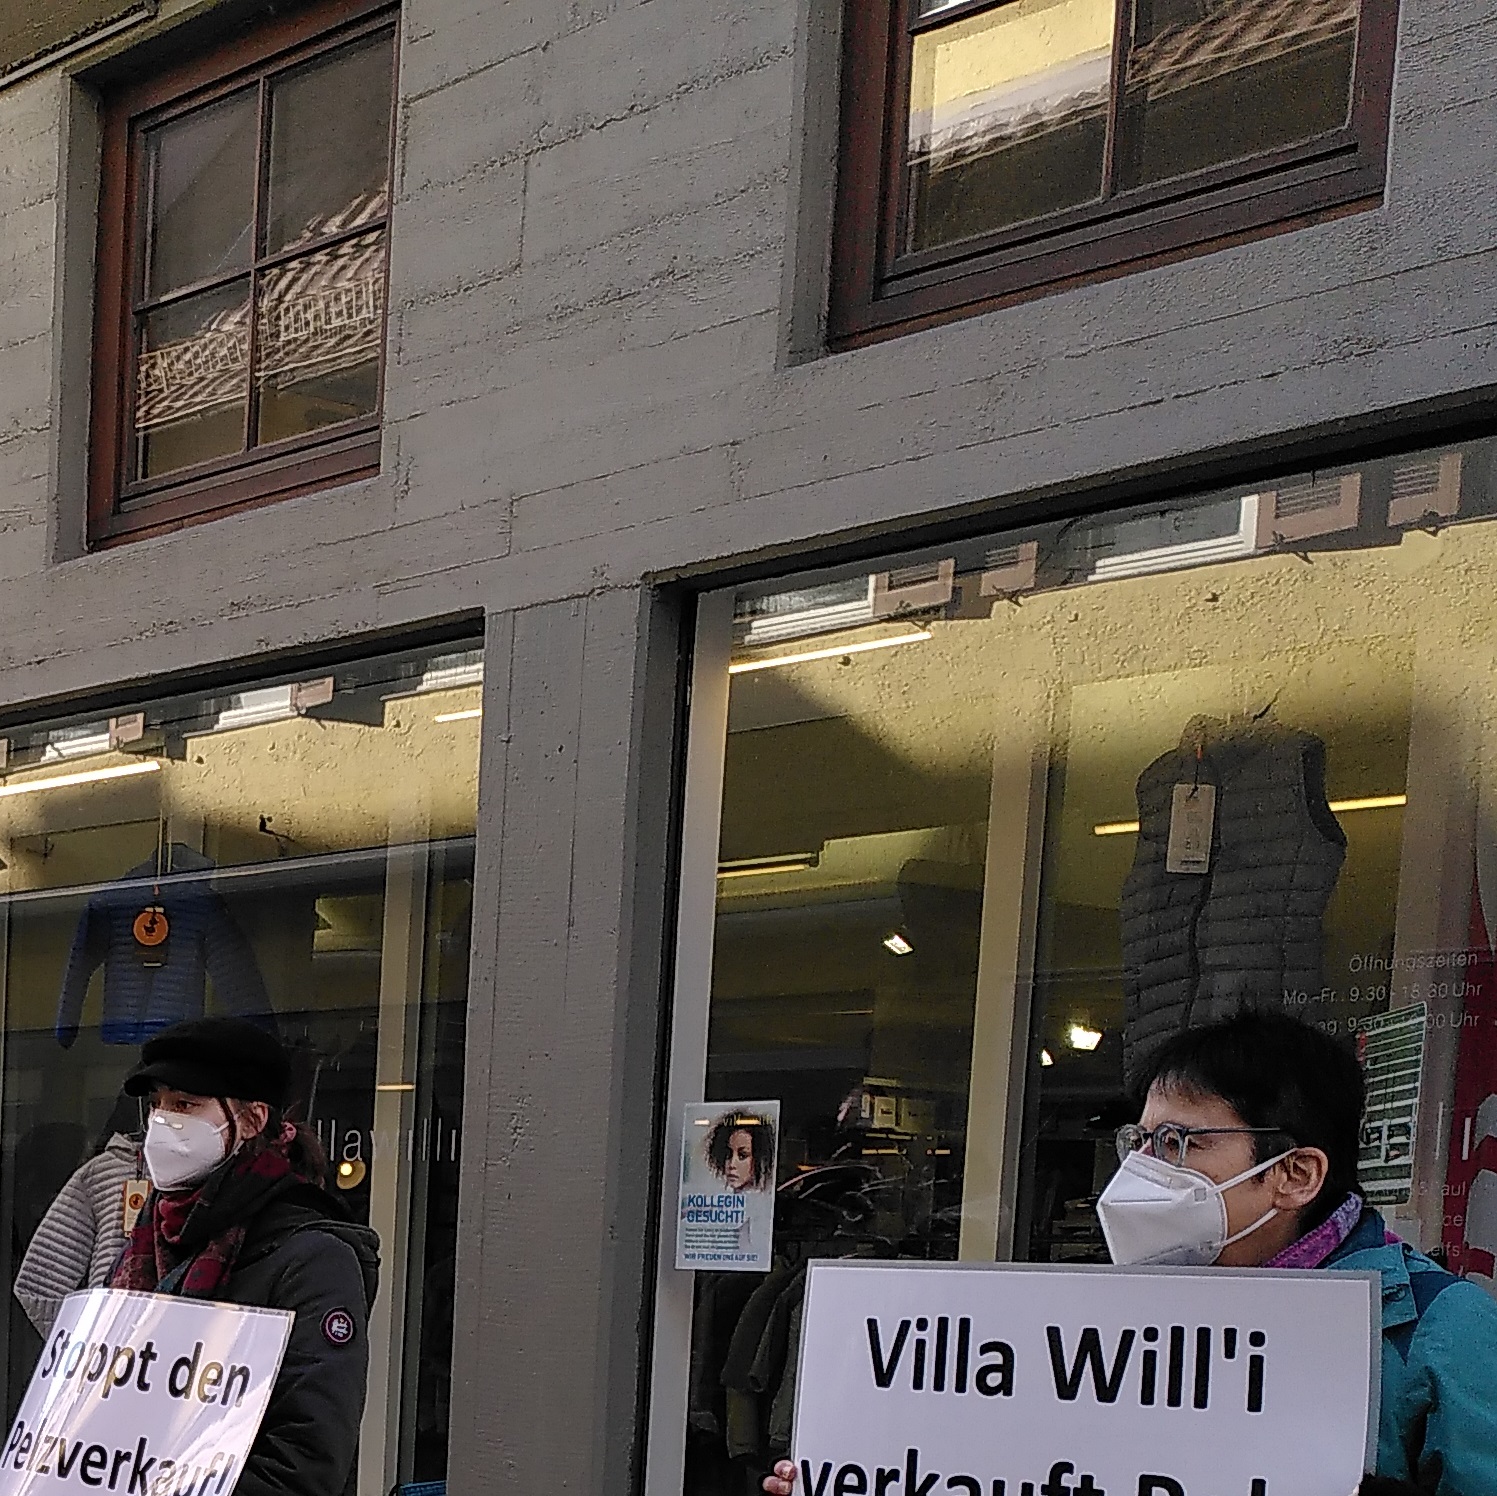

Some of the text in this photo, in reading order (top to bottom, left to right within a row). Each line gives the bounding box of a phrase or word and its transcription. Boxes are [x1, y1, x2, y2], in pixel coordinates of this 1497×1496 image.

[1452, 981, 1483, 998] Uhr
[1450, 1011, 1480, 1028] Uhr
[687, 1194, 745, 1208] KOLLEGIN
[686, 1210, 745, 1223] GESUCHT!
[41, 1328, 251, 1408] Stoppt den
[865, 1315, 1268, 1414] Villa Will'i
